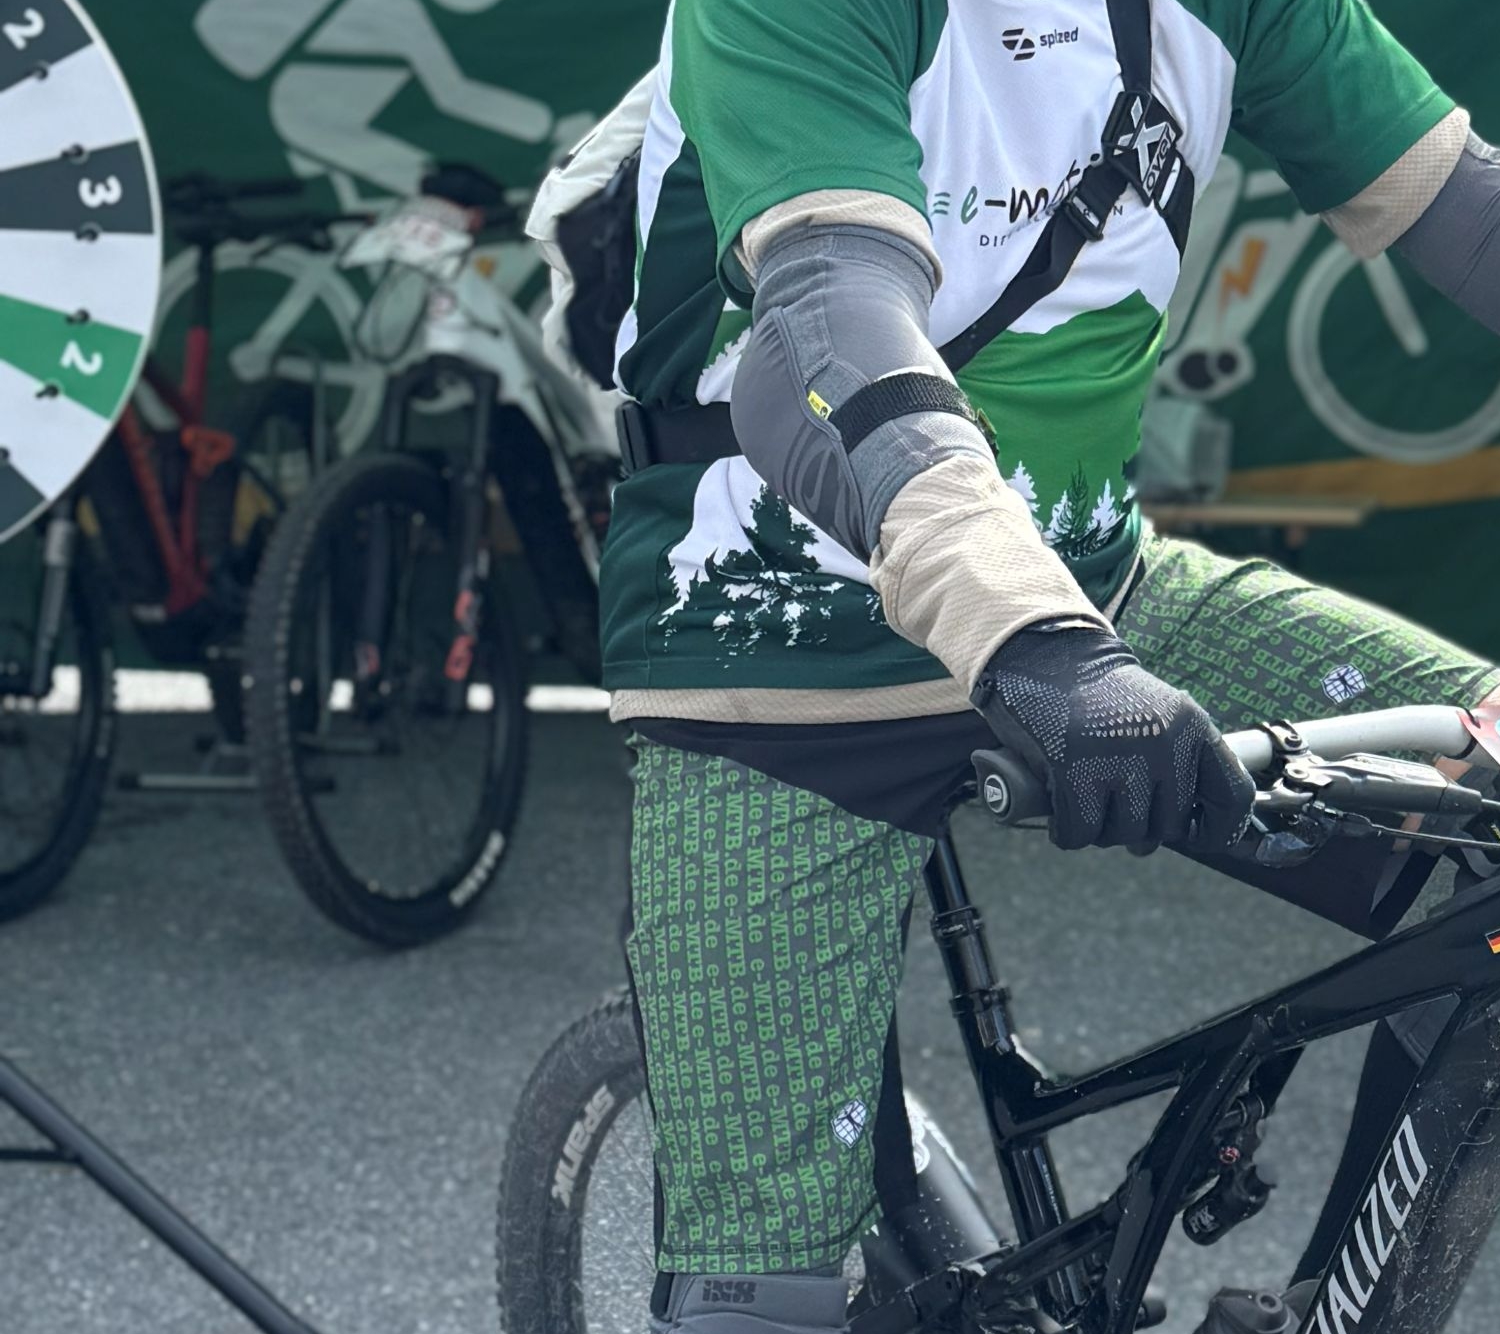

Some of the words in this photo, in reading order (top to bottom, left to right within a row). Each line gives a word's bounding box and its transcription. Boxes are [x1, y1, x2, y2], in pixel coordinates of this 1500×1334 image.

[3, 8, 46, 51] 2
[78, 175, 123, 209] 3
[61, 340, 103, 376] 2
[684, 774, 700, 892] e-MTB.de
[703, 827, 721, 949] e-MTB.de
[725, 769, 744, 888] e-MTB.de
[747, 824, 766, 944] e-MTB.de
[685, 898, 705, 1019] e-MTB.de
[725, 893, 749, 1015] e-MTB.de
[770, 888, 795, 1008] e-MTB.de
[813, 882, 832, 999] e-MTB.de
[707, 963, 734, 1085] e-MTB.de
[751, 958, 780, 1078] e-MTB.de
[779, 1013, 811, 1132] e-MTB.de
[795, 950, 824, 1069] e-MTB.de
[810, 1075, 837, 1189] e-MTB.de
[692, 1024, 720, 1146] e-MTB.de
[734, 1019, 765, 1139] e-MTB.de
[720, 1091, 753, 1208] e-MTB.de
[766, 1084, 796, 1200] e-MTB.de
